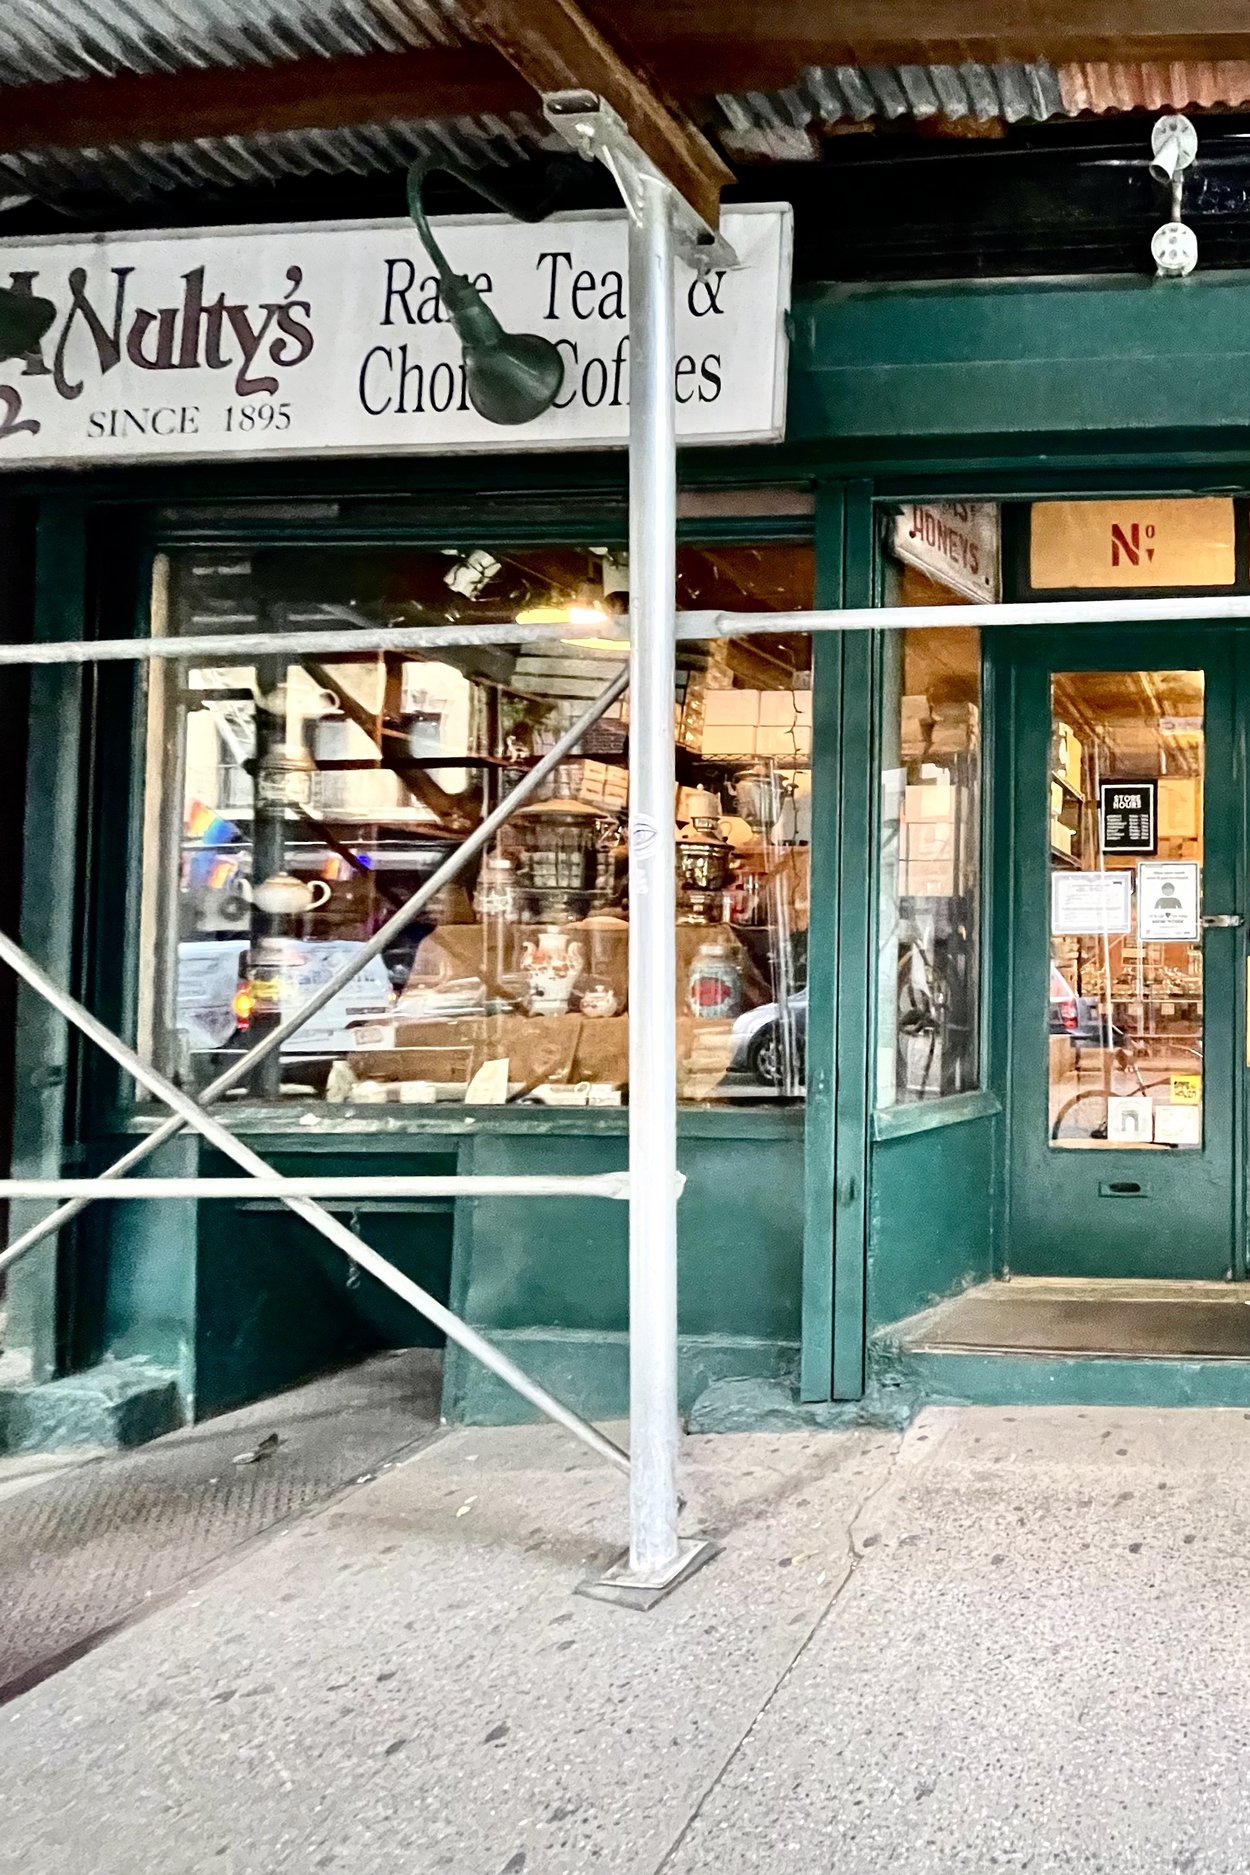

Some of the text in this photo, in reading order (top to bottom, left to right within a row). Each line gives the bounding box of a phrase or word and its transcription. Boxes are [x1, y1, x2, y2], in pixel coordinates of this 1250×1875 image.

[536, 252, 627, 320] Tea
[87, 403, 292, 438] SINCE 1895
[1112, 801, 1142, 809] HOURS
[1113, 794, 1142, 802] STORE
